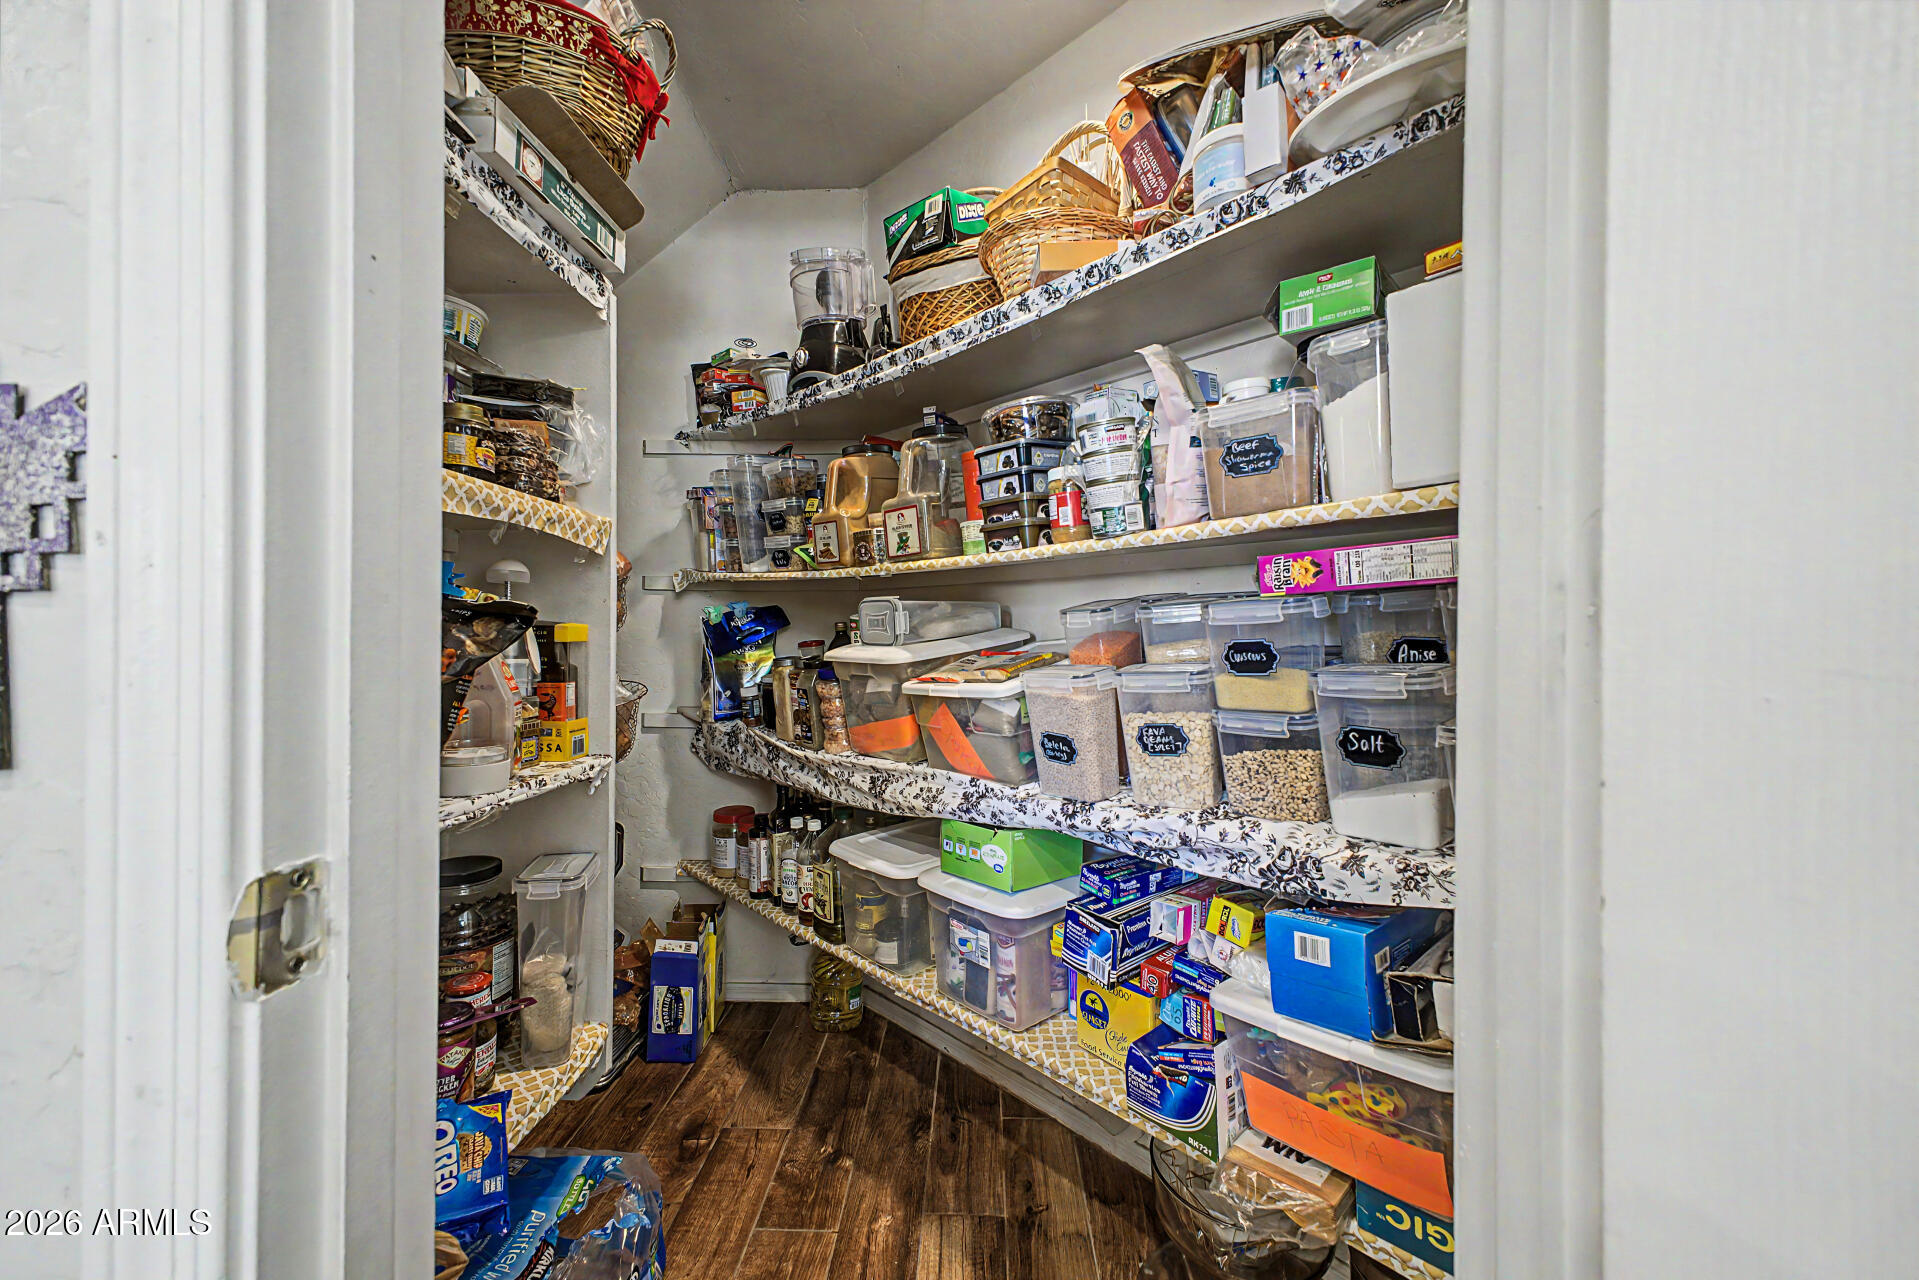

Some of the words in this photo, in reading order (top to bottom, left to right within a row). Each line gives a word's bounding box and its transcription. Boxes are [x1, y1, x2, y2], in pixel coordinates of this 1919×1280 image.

[1133, 141, 1153, 173] FASTEST
[1146, 168, 1159, 191] WAY
[1154, 185, 1164, 200] TO
[1147, 150, 1161, 175] EASIEST
[1231, 439, 1260, 454] Beef
[1239, 459, 1271, 472] Spice
[1273, 557, 1285, 591] Raisin
[1282, 559, 1293, 588] Bran
[1398, 644, 1437, 663] Anise
[1142, 726, 1166, 736] FAVA
[1348, 731, 1384, 755] Salt
[1082, 1010, 1107, 1029] SUNSET
[1081, 1039, 1097, 1053] Food
[1099, 1048, 1122, 1066] Service
[1284, 1101, 1384, 1165] PASTA
[436, 1120, 458, 1195] OREO
[494, 1209, 546, 1273] purified
